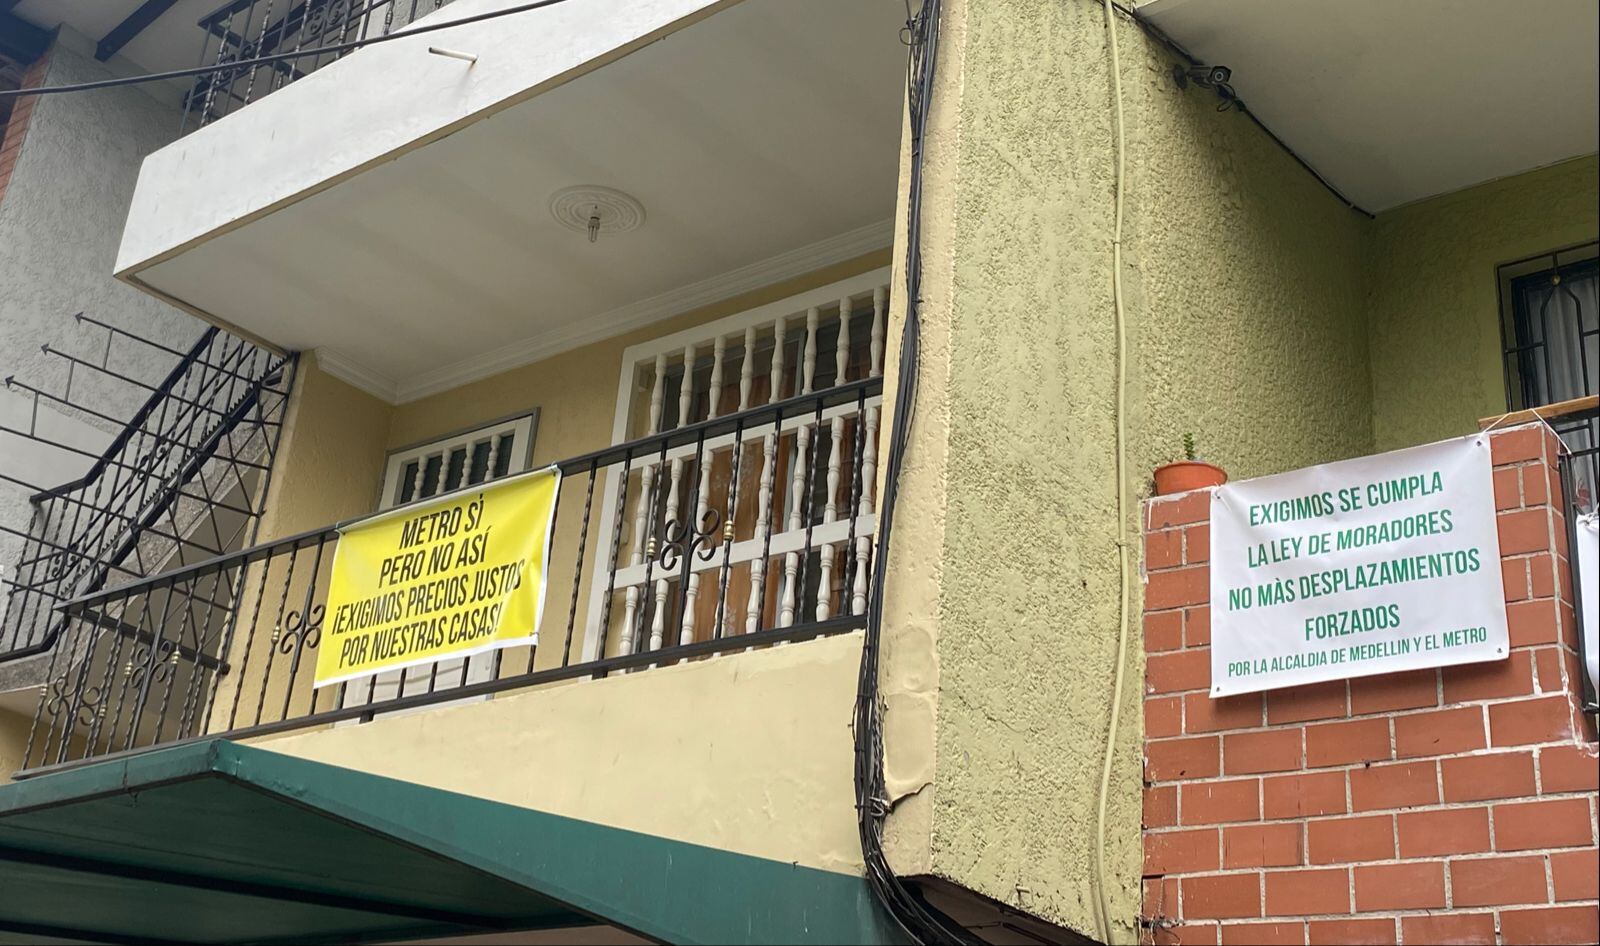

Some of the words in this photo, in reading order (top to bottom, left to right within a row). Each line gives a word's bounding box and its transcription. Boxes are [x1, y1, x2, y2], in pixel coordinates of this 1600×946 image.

[399, 506, 462, 550] METRO
[1250, 492, 1334, 526] EXIGIMOS
[1340, 488, 1363, 512] SE
[1368, 471, 1443, 507] CUMPLA
[378, 550, 426, 588] PERO
[427, 541, 455, 576] NO
[456, 526, 492, 568] ASÍ
[1248, 544, 1268, 569] LA
[1270, 537, 1304, 563] LEY
[1308, 532, 1331, 556] DE
[1336, 509, 1453, 552] MORADORES
[332, 591, 405, 635] ¡EXIGIMOS
[406, 574, 468, 618] PRECIOS
[470, 559, 526, 603] JUSTOS
[1228, 587, 1252, 611] NO
[1300, 548, 1481, 600] DESPLAZAMIENTOS
[339, 635, 370, 668] POR
[370, 614, 449, 661] NUESTRAS
[449, 602, 503, 644] CASAS!
[1228, 661, 1251, 677] POR
[1254, 659, 1268, 674] LA
[1271, 651, 1328, 672] ALCALDIA
[1331, 649, 1347, 664] DE
[1350, 641, 1410, 662] MEDELLIN
[1413, 637, 1422, 654] Y
[1425, 635, 1440, 650] EL
[1443, 627, 1487, 648] METRO
[1305, 604, 1400, 641] FORZADOS
